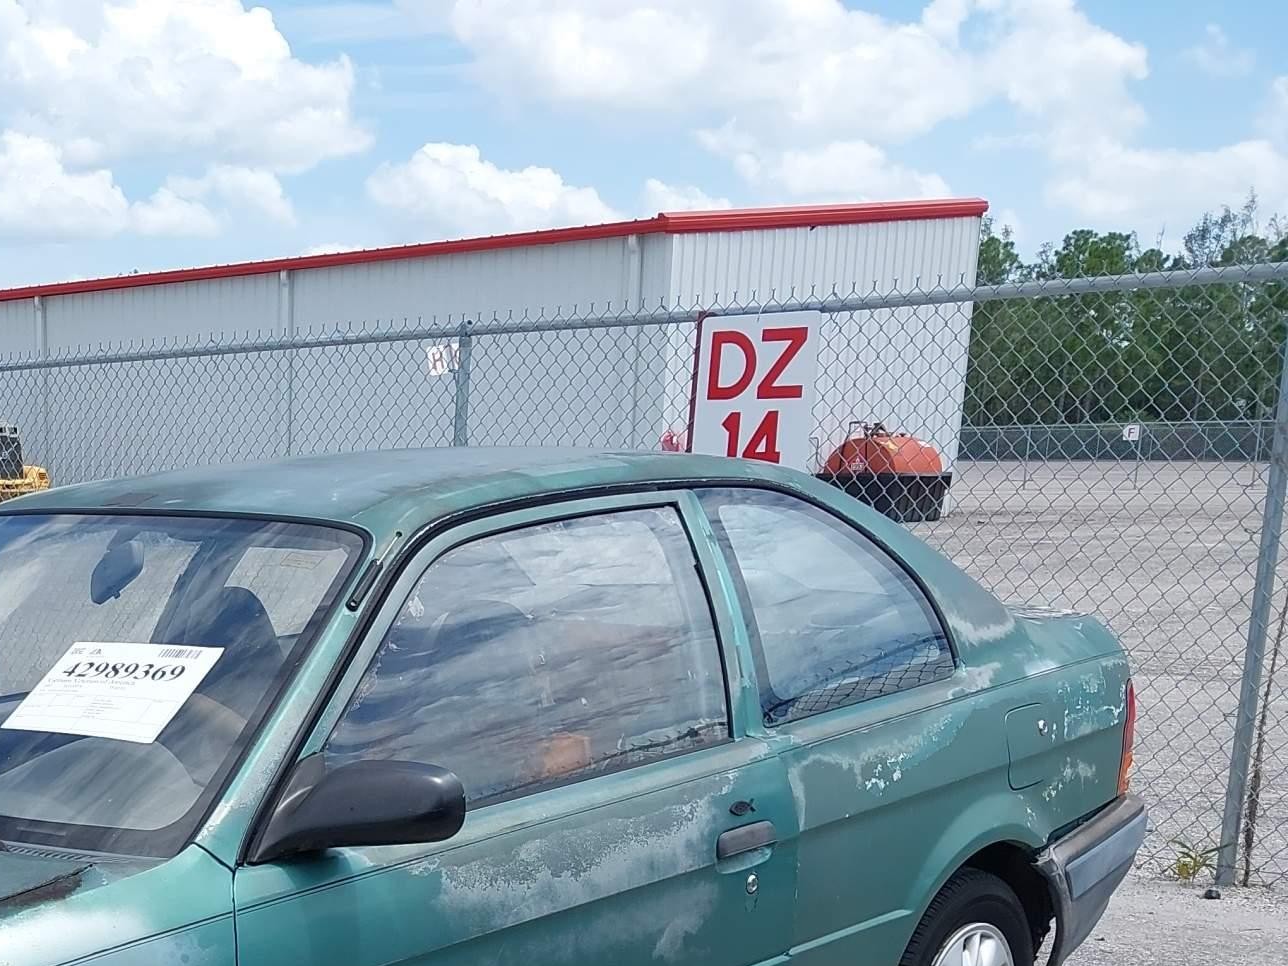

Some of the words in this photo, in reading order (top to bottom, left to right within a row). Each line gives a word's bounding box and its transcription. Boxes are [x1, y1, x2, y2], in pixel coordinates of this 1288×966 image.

[706, 326, 809, 401] DZ
[721, 410, 781, 464] 14
[62, 660, 186, 682] 42989369
